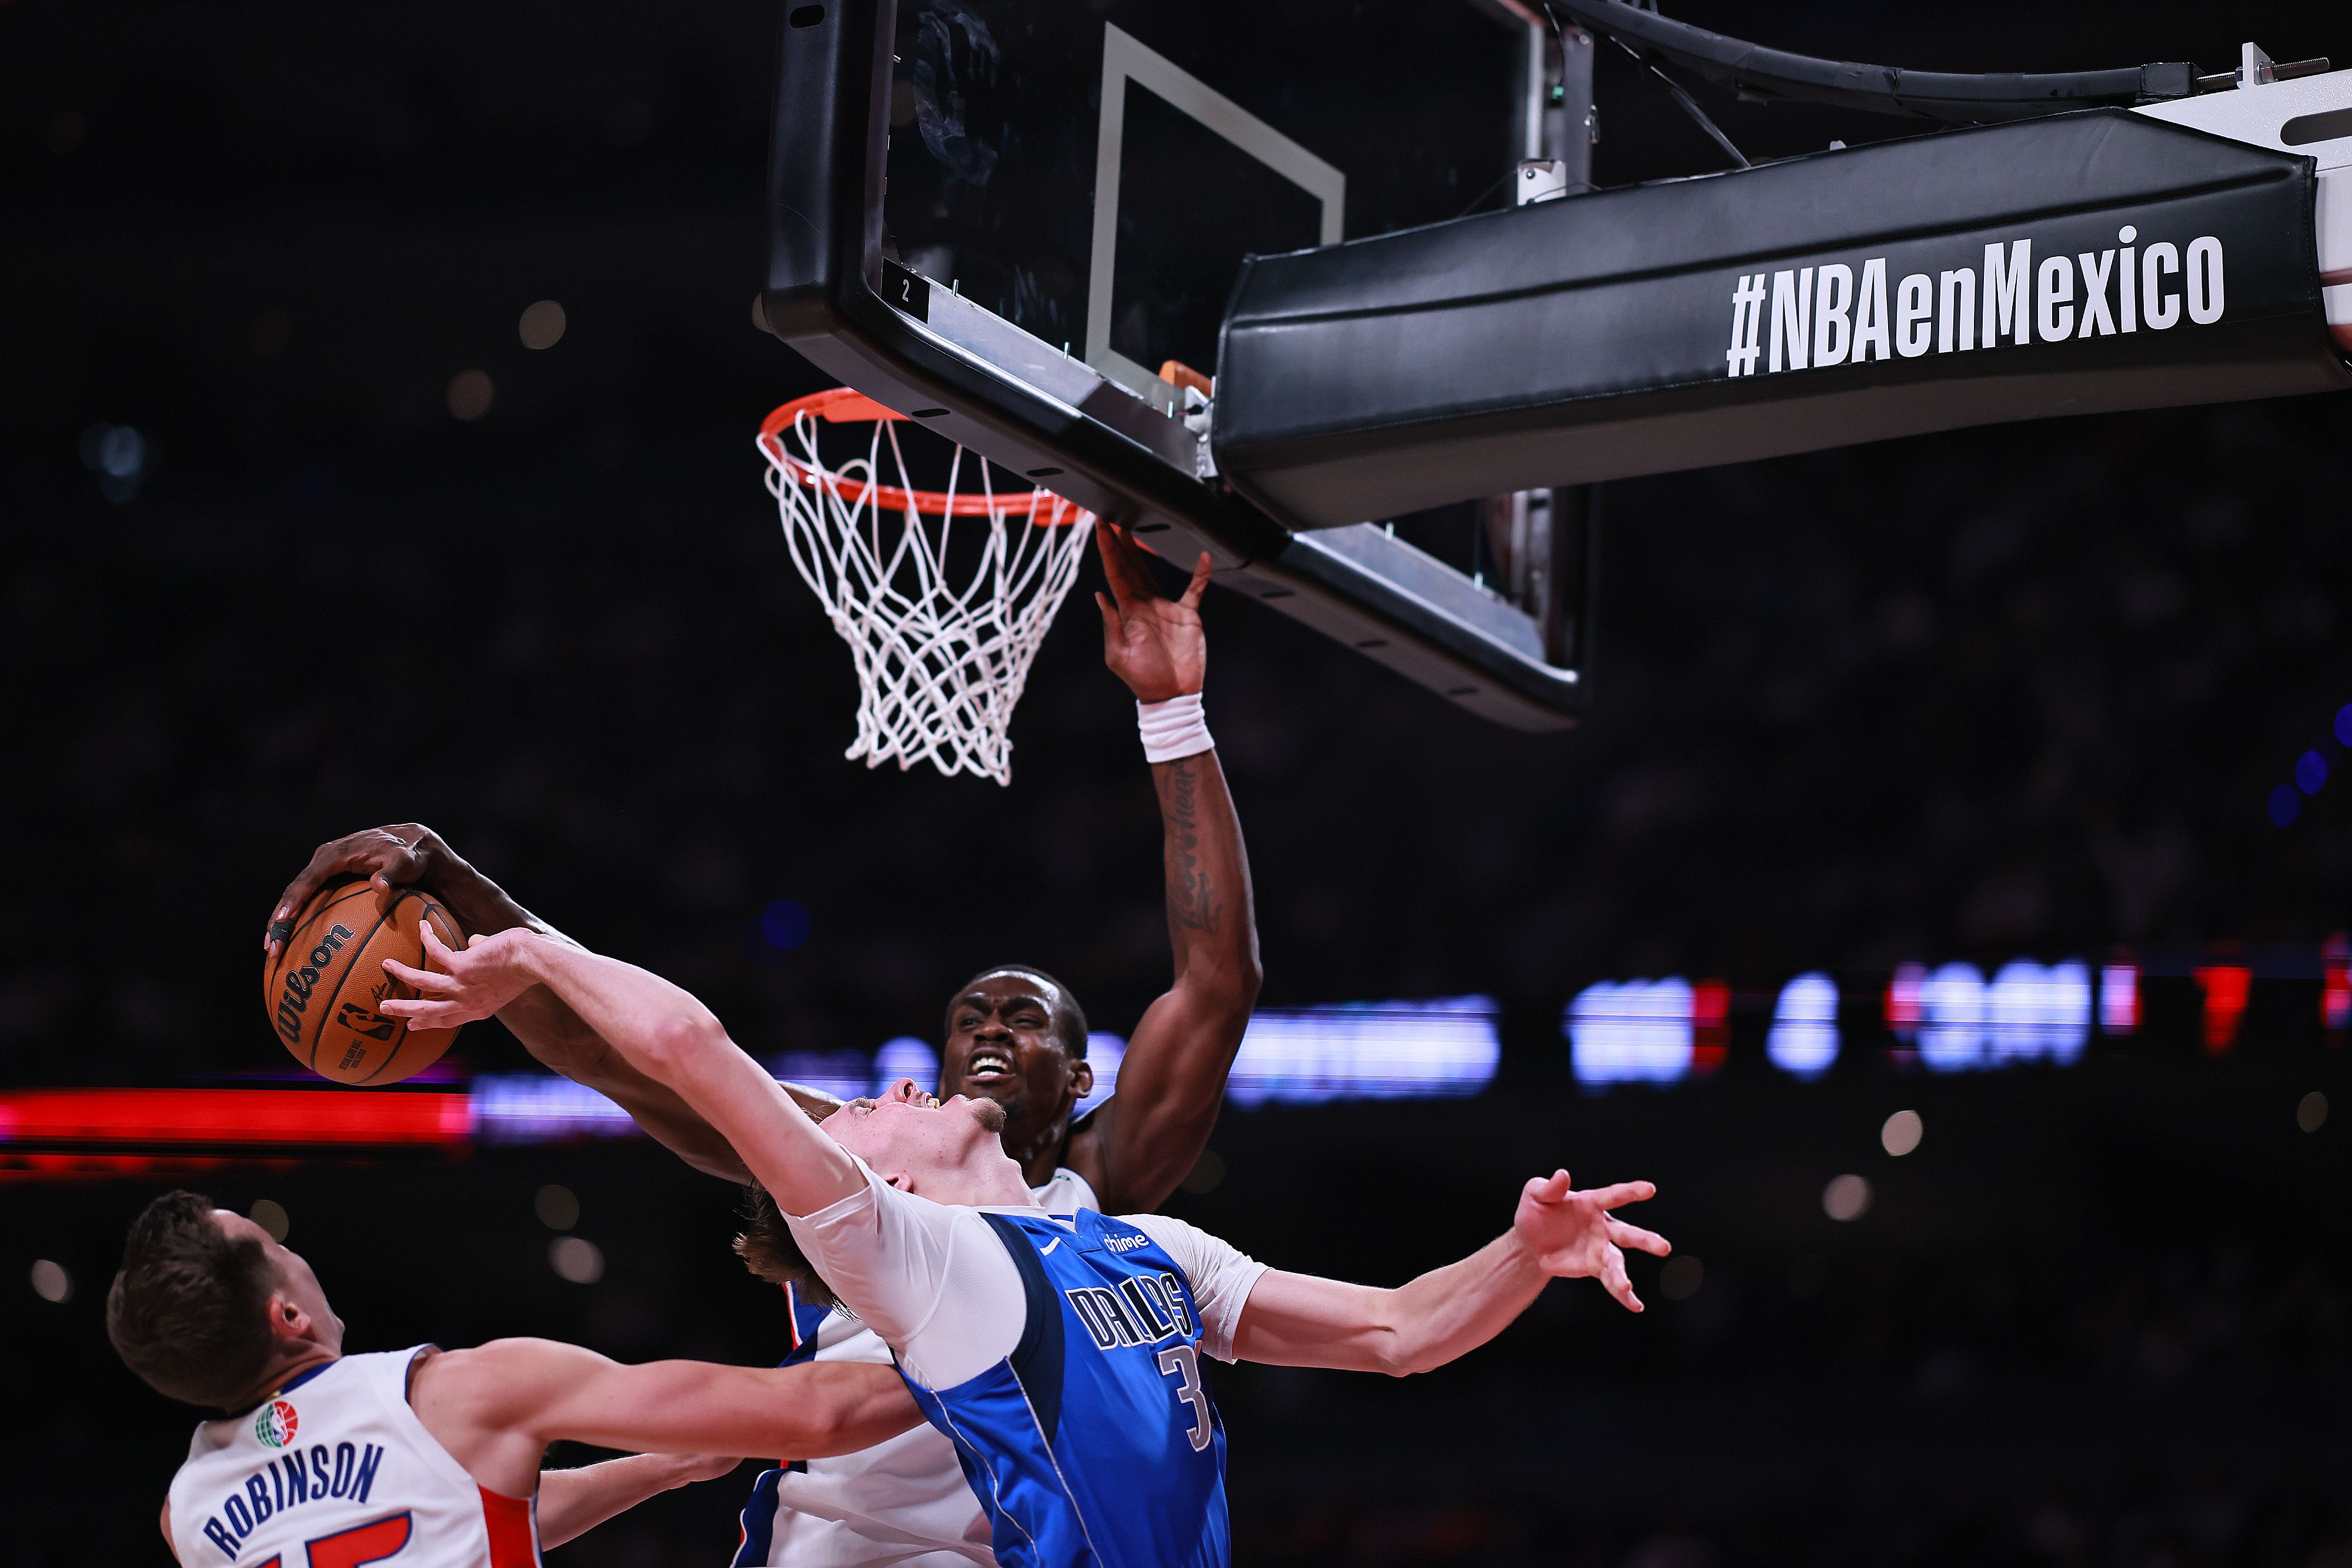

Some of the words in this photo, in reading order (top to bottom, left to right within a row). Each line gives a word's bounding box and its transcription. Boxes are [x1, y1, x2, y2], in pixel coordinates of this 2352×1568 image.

[902, 279, 910, 302] 2
[1726, 225, 2224, 377] #NBAenMexico
[278, 923, 356, 1044] Wilson
[1104, 1233, 1150, 1253] chime
[204, 1442, 384, 1561] ROBINSON
